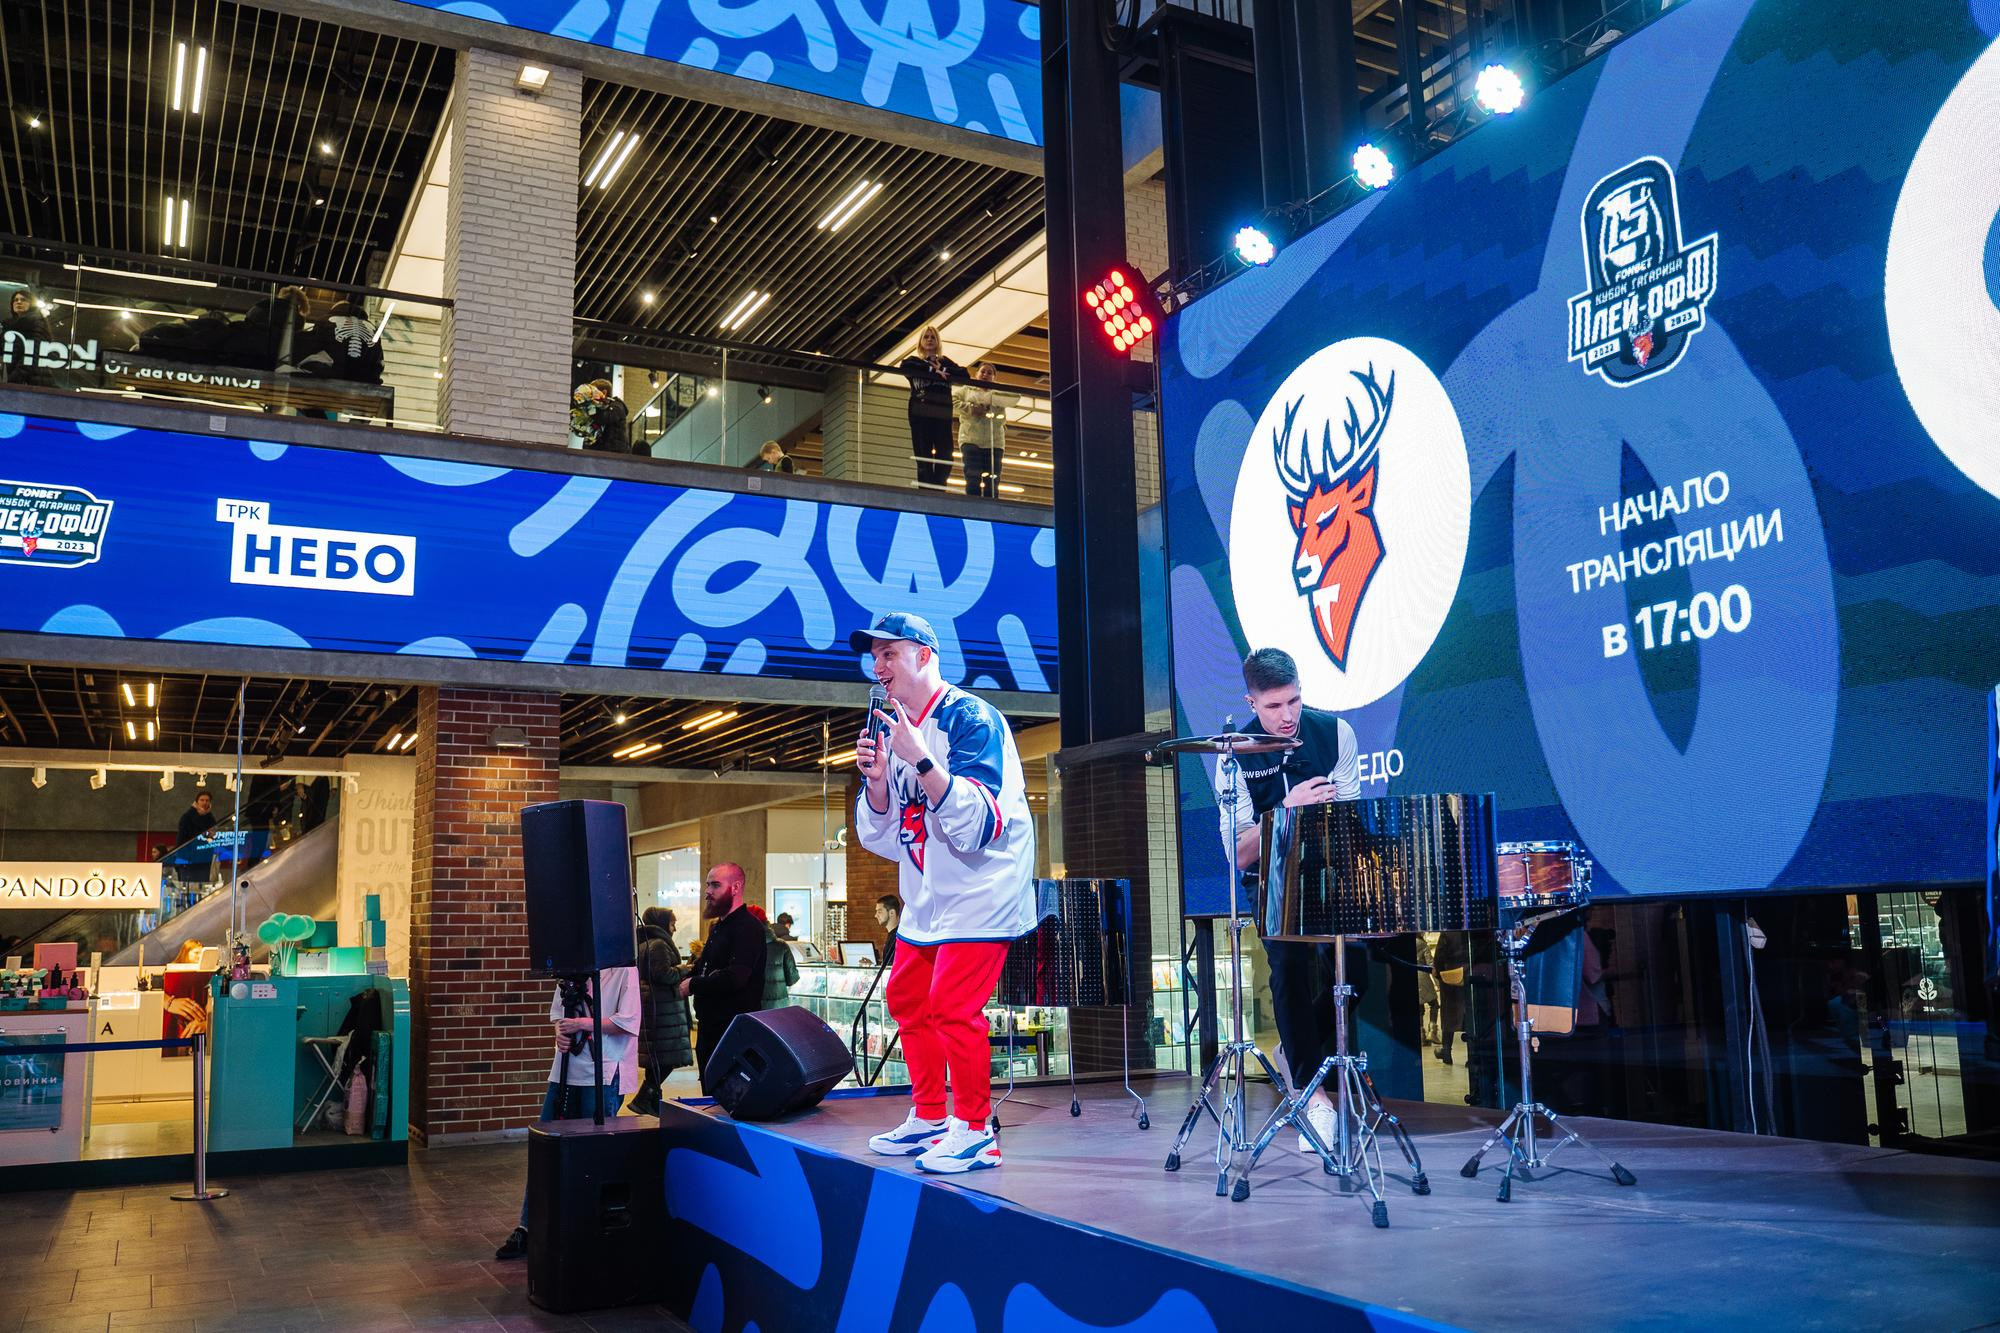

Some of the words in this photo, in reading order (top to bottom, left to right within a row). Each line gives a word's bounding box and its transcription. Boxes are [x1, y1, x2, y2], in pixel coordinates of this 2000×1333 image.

[1615, 257, 1653, 282] FONBET
[1595, 281, 1628, 306] КУБОК
[1631, 258, 1683, 293] ГАГАРИНА
[1574, 245, 1710, 351] ПЛЕЙ-ОФФ
[1671, 312, 1693, 328] 2023
[1594, 343, 1614, 358] 2022
[16, 487, 62, 500] FONBET
[1599, 470, 1730, 536] НАЧАЛО
[34, 500, 82, 512] ГАГАРИНА
[226, 504, 261, 520] ТРК
[57, 541, 85, 551] 2023
[1566, 508, 1784, 594] ТРАНСЛЯЦИИ
[244, 533, 405, 583] НЕБО
[1635, 584, 1752, 650] 17:00
[0, 1076, 57, 1086] ОВИНКИ
